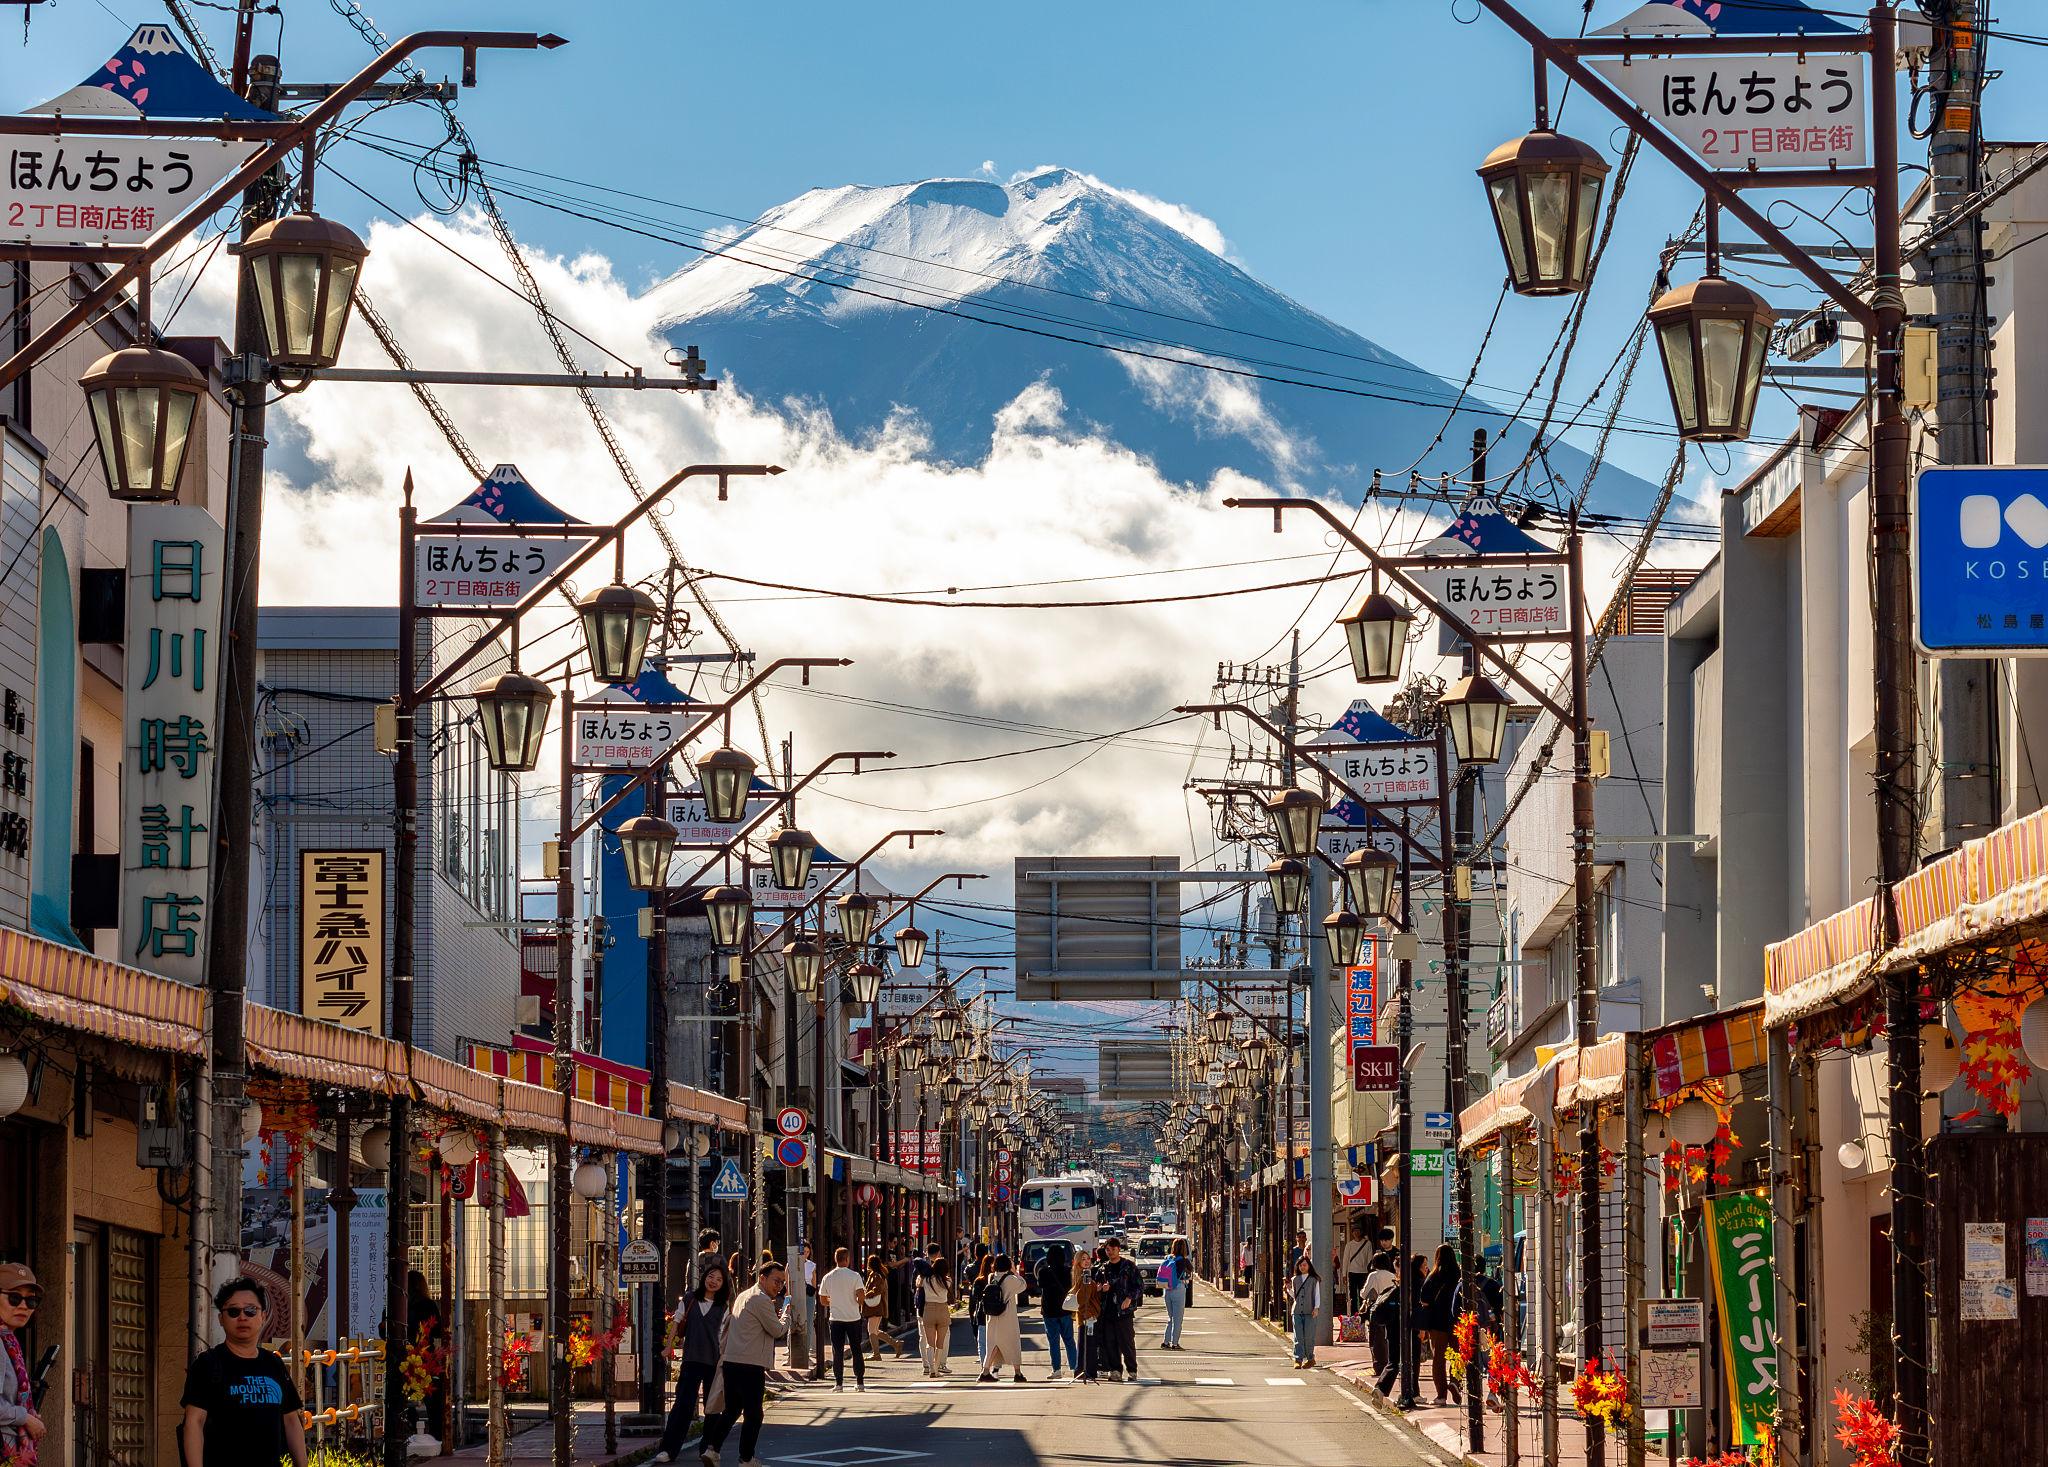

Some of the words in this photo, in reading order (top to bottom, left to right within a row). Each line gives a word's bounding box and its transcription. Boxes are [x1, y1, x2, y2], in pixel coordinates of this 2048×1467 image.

[1662, 68, 1853, 117] ほんちょう
[1701, 125, 1854, 155] 2丁目商店街
[10, 148, 194, 195] ほんちょう
[7, 201, 155, 232] 2丁目商店街
[427, 544, 546, 575] ほんちょう
[426, 579, 521, 598] 2丁目商店街
[1446, 573, 1558, 603] ほんちょう
[1470, 606, 1559, 625] 2丁目商店街
[582, 719, 673, 742] ほんちょう
[135, 539, 209, 958] 日川時計店
[581, 744, 653, 759] 2丁目商店街
[1345, 754, 1429, 778] ほんちょう
[1363, 778, 1430, 794] 2丁目商店街
[675, 827, 732, 838] 丁目商店街
[313, 856, 371, 1031] 富士急ハイラ
[784, 1115, 800, 1129] 40
[1033, 1211, 1082, 1220] SUSOBANA
[368, 1231, 377, 1339] お気軽にお入りくださ
[229, 1385, 266, 1395] MOUNT
[244, 1375, 265, 1385] THE
[243, 1394, 269, 1404] FUJI
